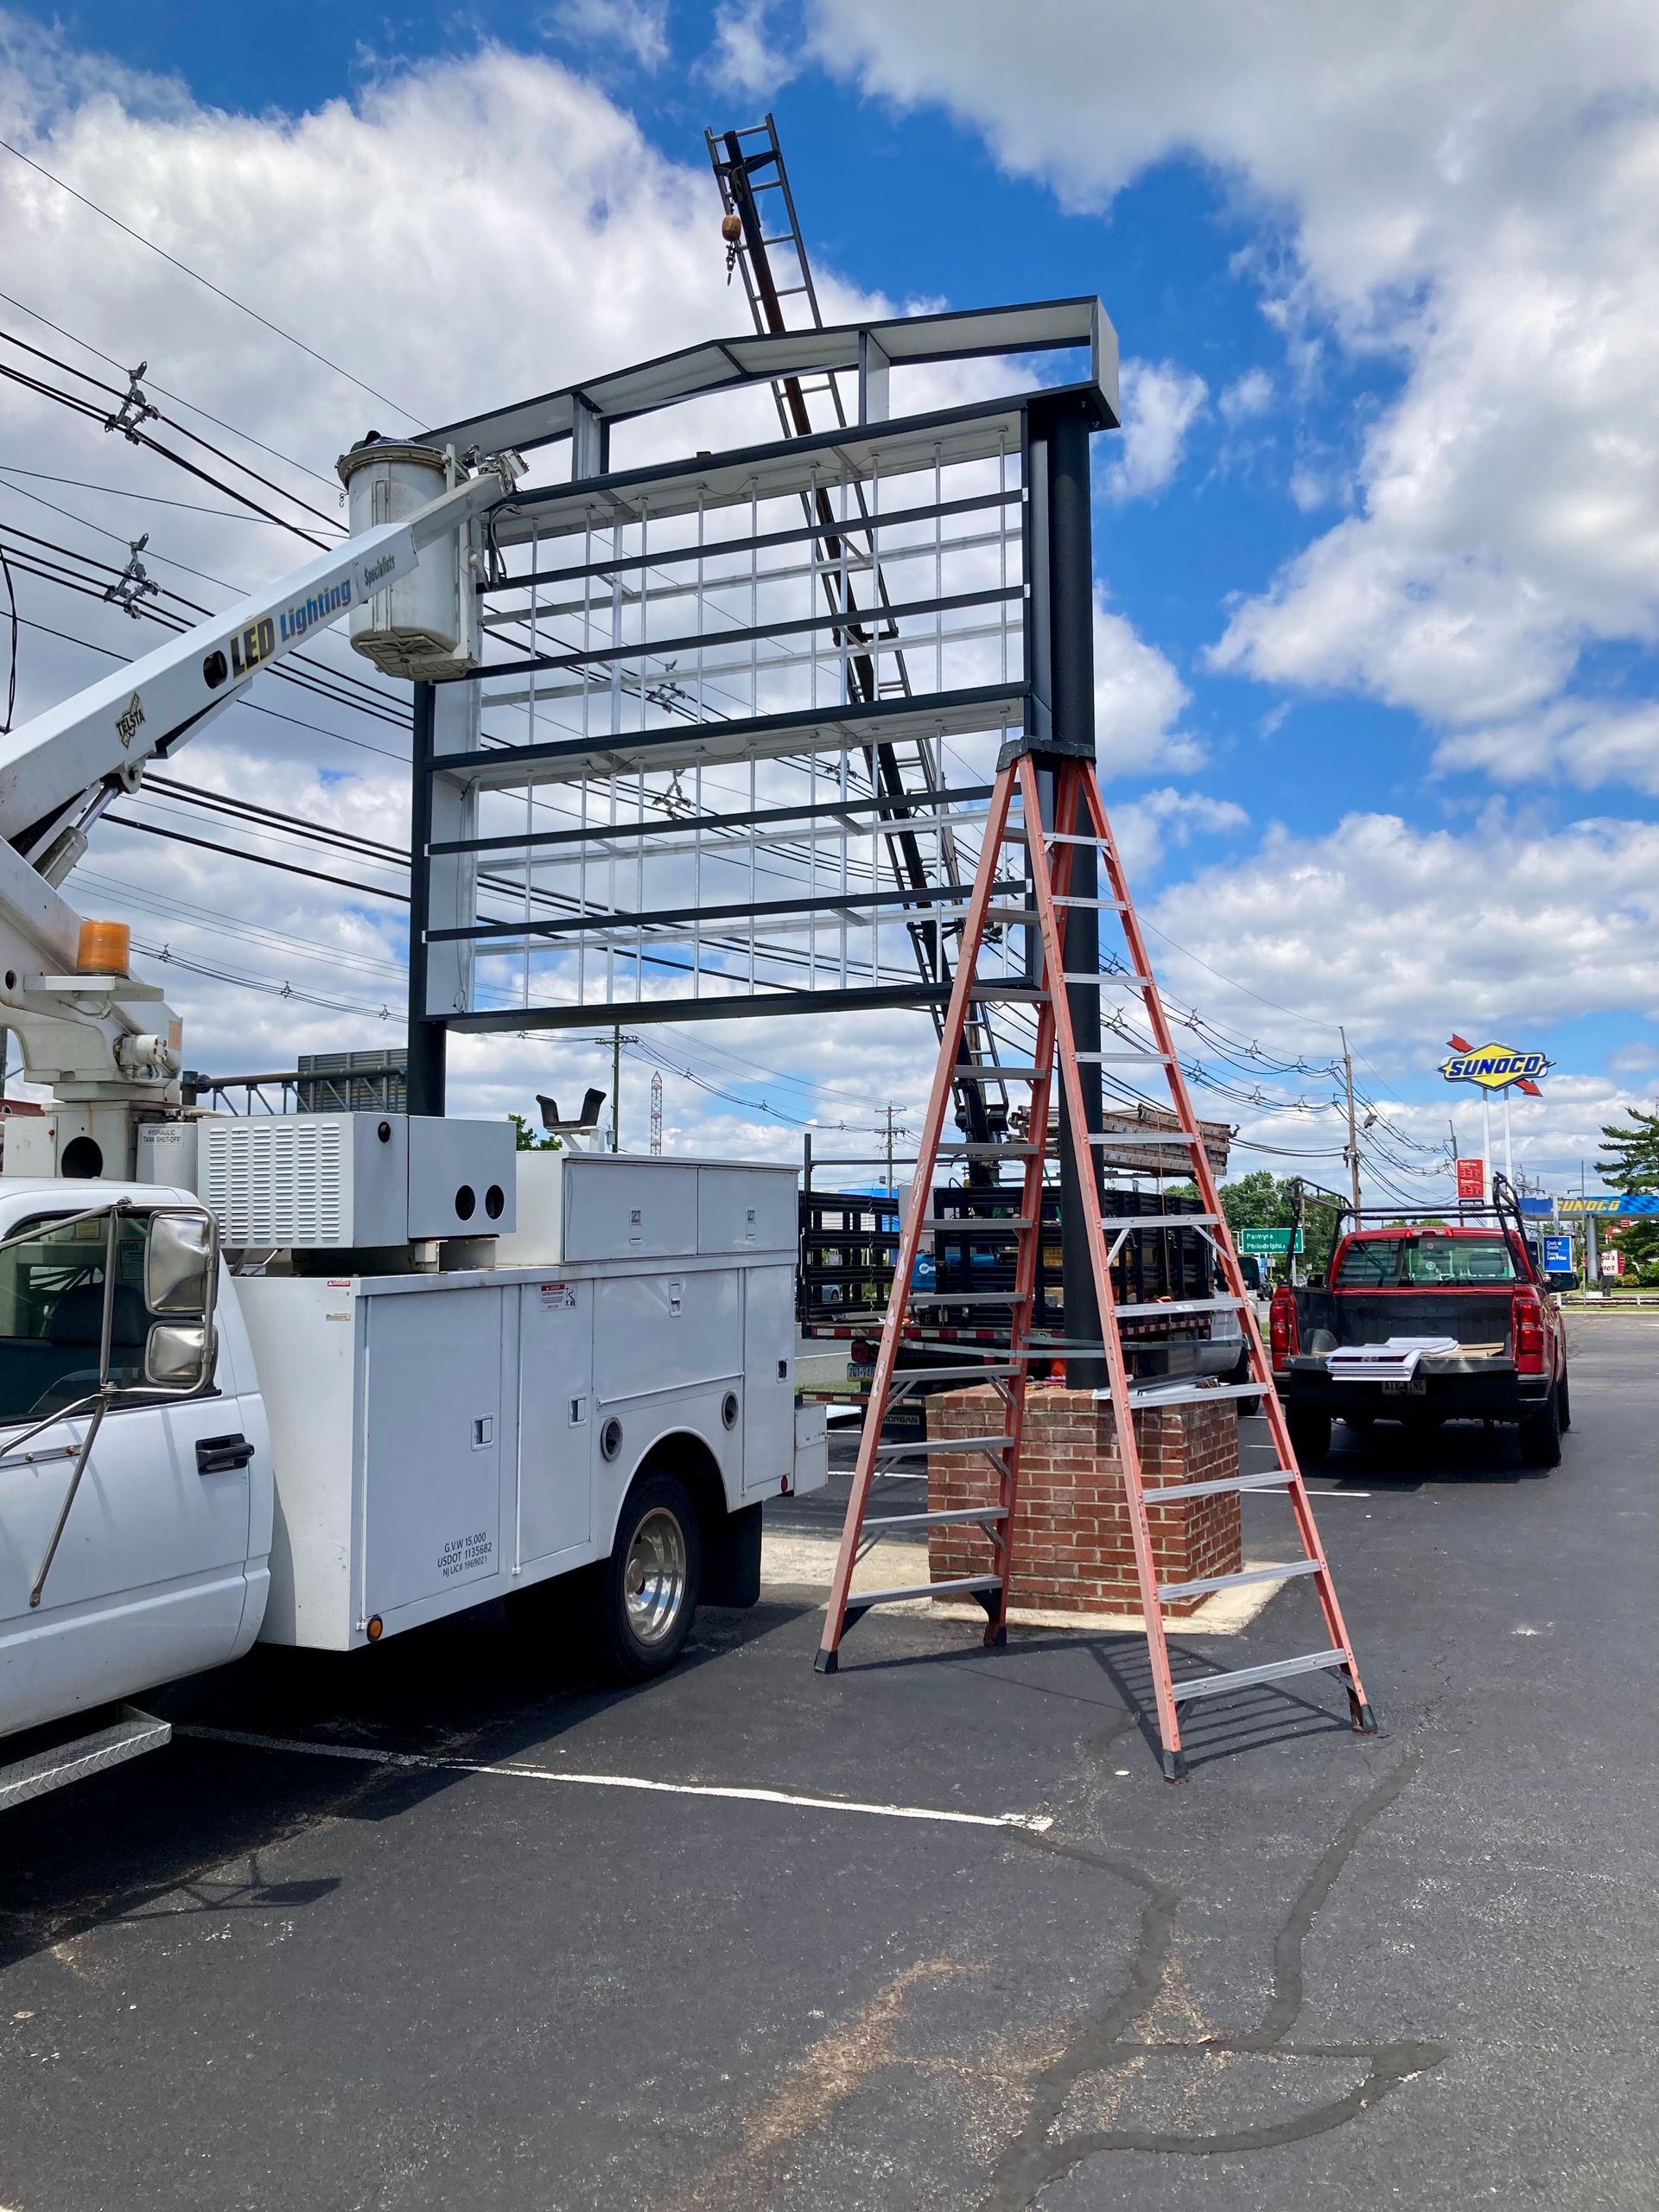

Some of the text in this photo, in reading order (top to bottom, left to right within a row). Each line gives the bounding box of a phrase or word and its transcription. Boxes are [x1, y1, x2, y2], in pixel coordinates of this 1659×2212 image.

[230, 615, 276, 680] LED
[280, 578, 352, 643] Lighting
[116, 709, 146, 737] TELSTA
[1449, 1056, 1541, 1077] SUNOCO
[465, 1531, 486, 1547] 15,000
[437, 1541, 492, 1567] USDOT 1135682
[442, 1554, 487, 1578] NJ LIC# 1969021
